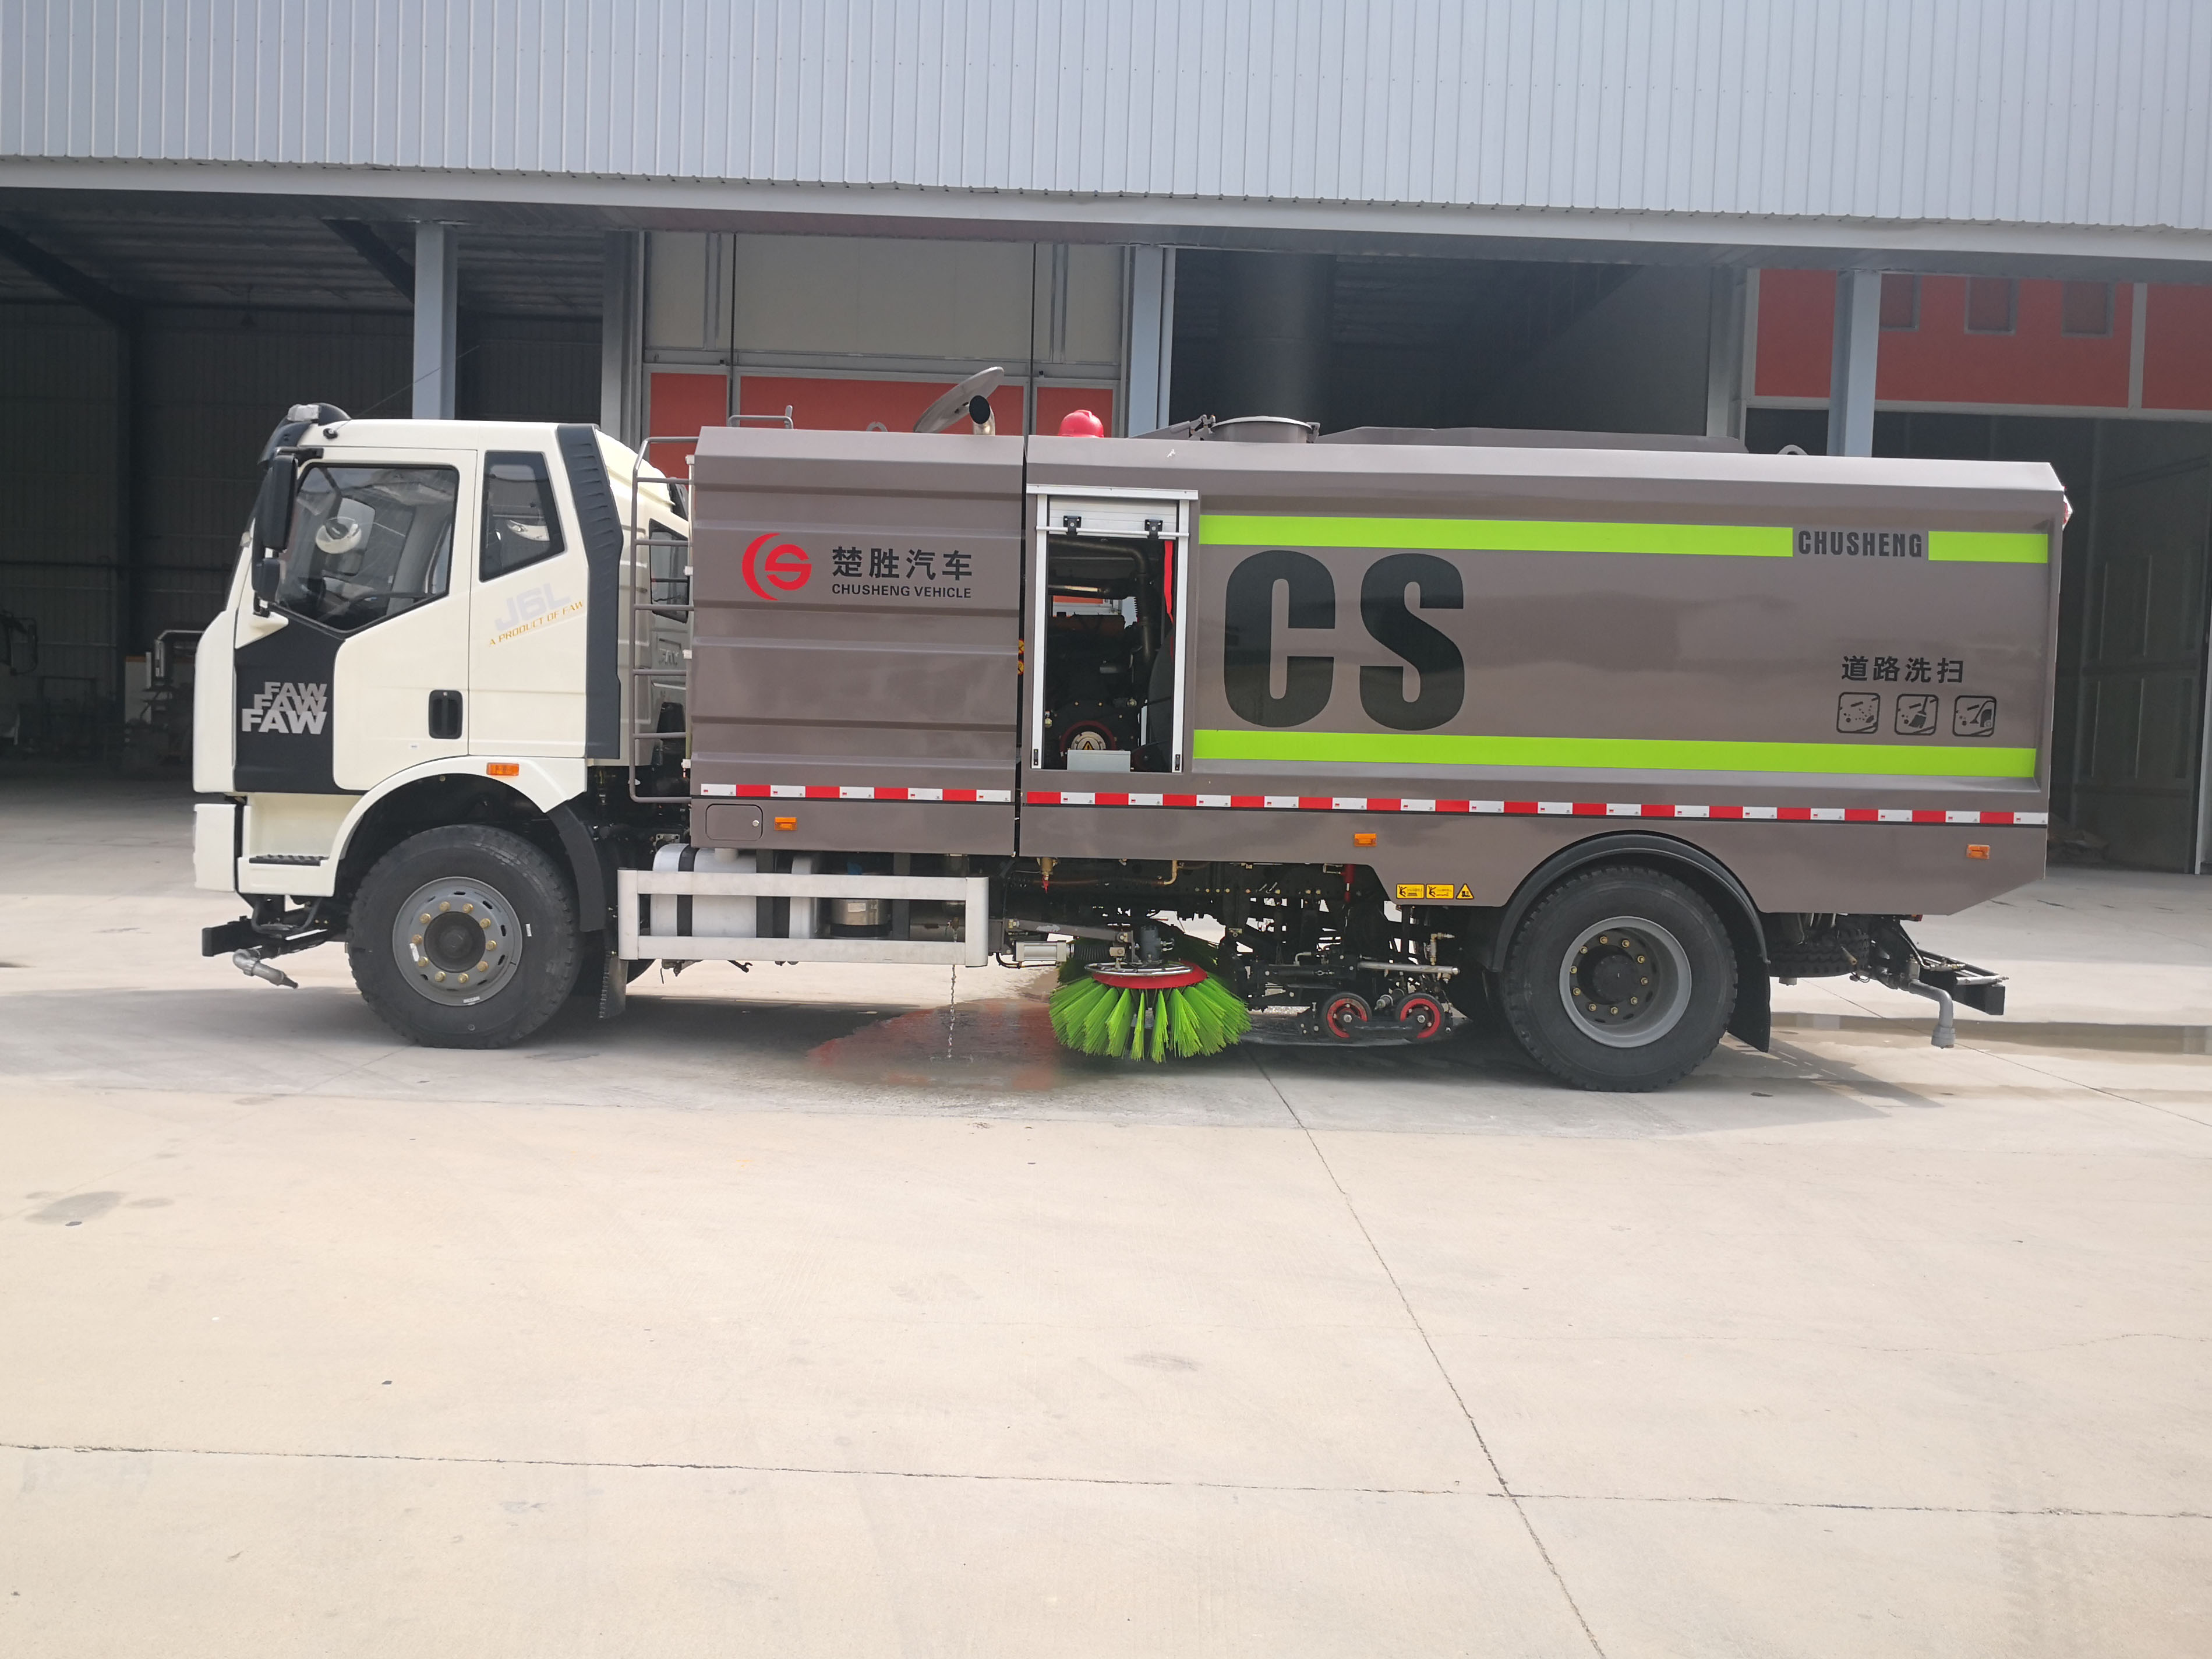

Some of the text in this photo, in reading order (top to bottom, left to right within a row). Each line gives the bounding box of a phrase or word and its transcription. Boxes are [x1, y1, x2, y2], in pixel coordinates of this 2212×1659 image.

[1798, 530, 1922, 557] CHUSHENG
[832, 546, 973, 581] 楚胜汽车
[832, 583, 971, 599] CHUSHENG VEHICLE
[495, 583, 572, 632] J6L
[489, 599, 584, 648] A PRODUCT OF FAW
[1224, 550, 1465, 731] CS
[1841, 655, 1964, 684] 道路洗扫
[253, 693, 327, 716] FAW
[264, 681, 327, 701] FAW
[242, 708, 327, 735] FAW
